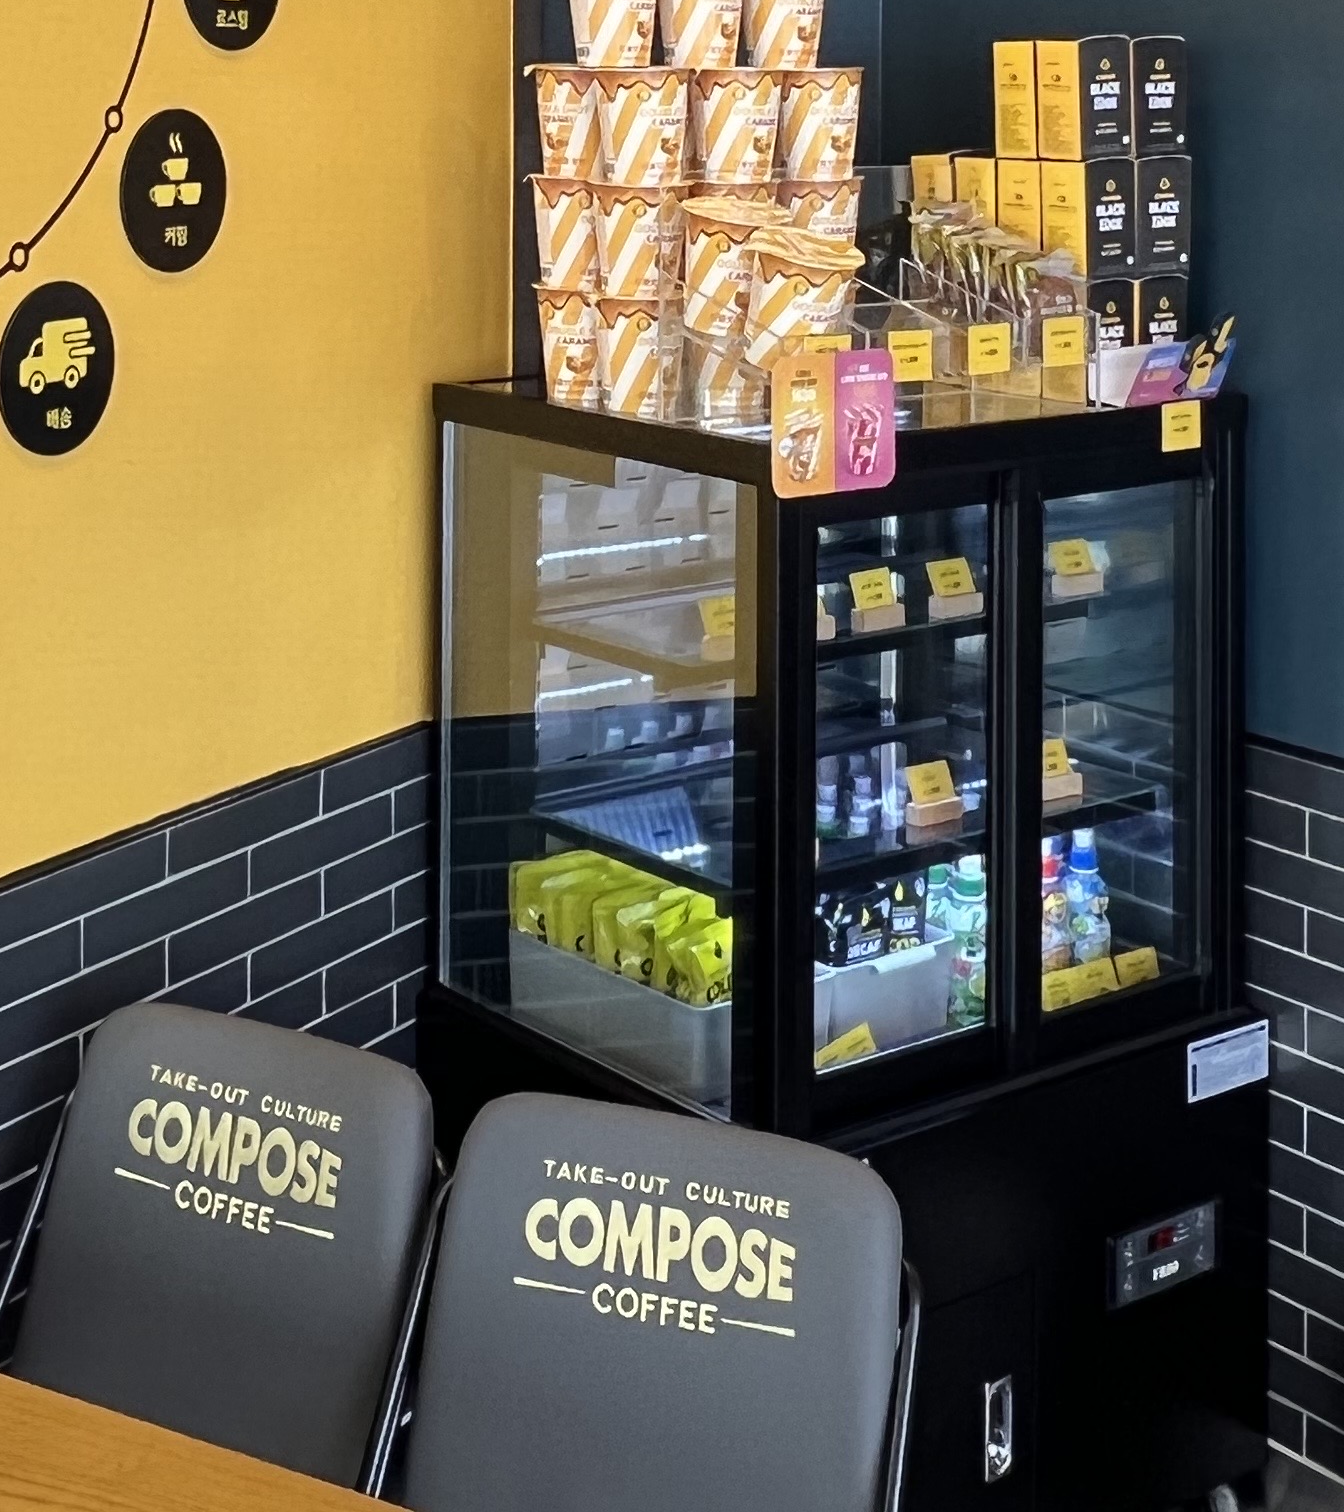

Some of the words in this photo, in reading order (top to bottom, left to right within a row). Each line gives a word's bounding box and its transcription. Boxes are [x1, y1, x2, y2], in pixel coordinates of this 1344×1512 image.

[150, 1064, 250, 1106] TAKE-OUT
[260, 1095, 343, 1133] CULTURE
[128, 1098, 343, 1209] COMPOSE
[174, 1179, 275, 1234] COFFEE
[543, 1159, 671, 1196] TAKE-OUT
[685, 1181, 791, 1219] CULTURE
[524, 1197, 797, 1302] COMPOSE
[591, 1282, 719, 1334] COFFEE
